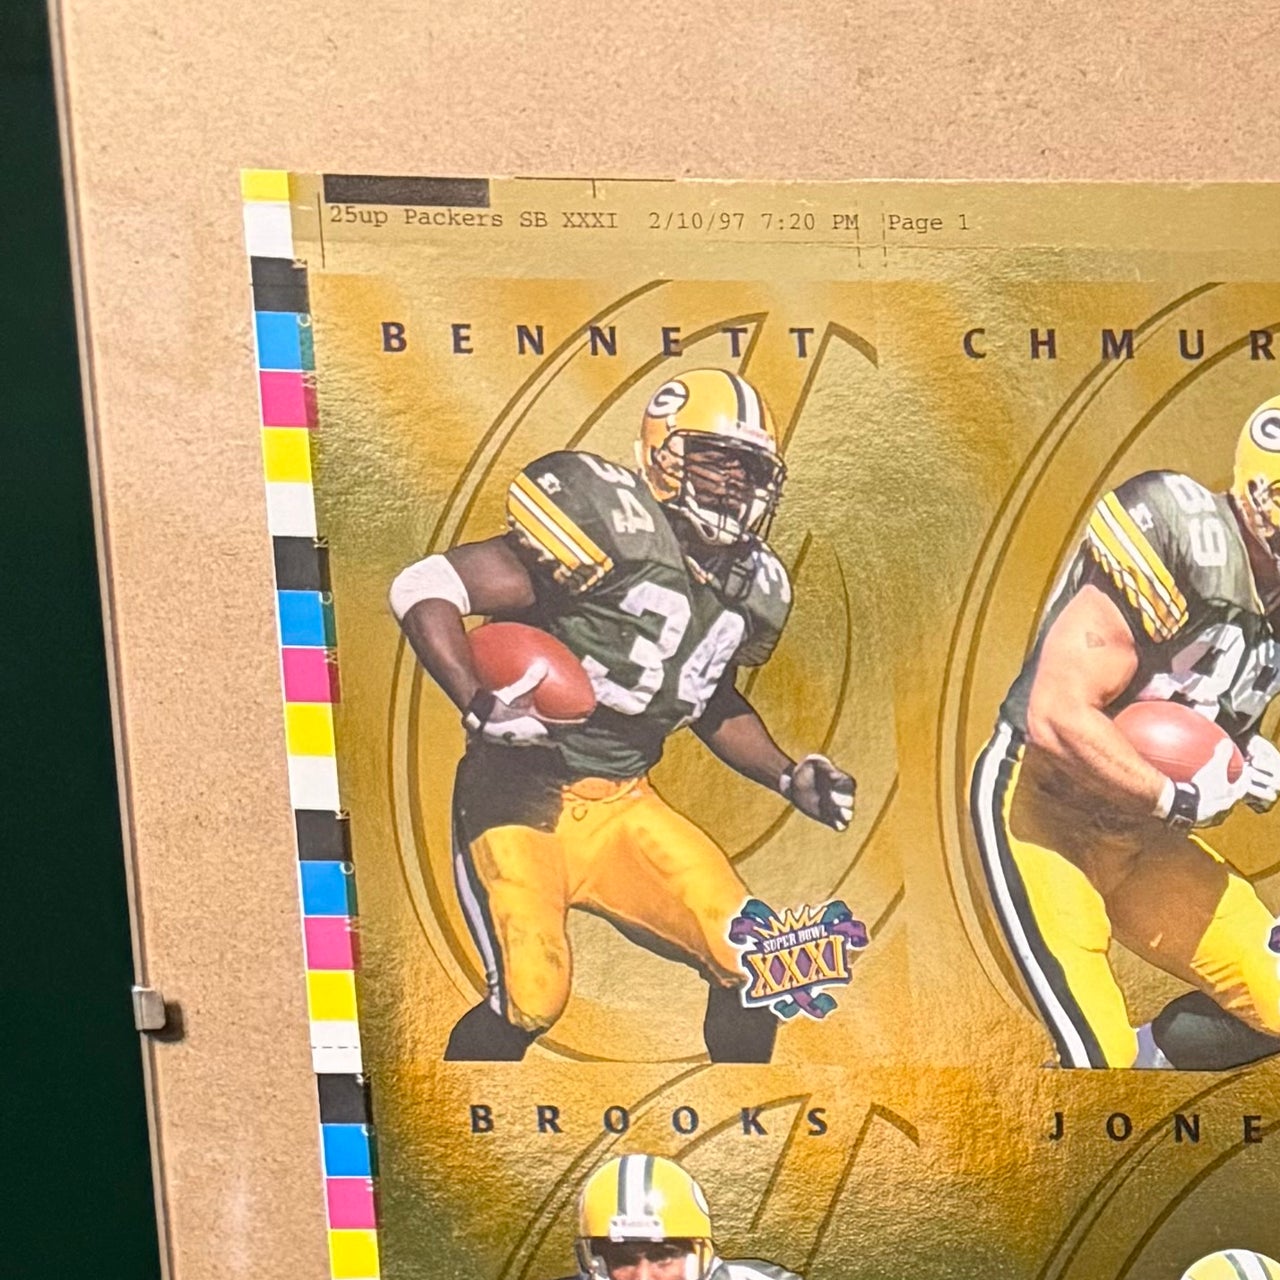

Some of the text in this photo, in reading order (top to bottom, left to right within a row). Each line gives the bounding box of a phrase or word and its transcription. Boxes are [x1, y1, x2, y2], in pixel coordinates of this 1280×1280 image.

[330, 205, 859, 231] 25up Packers SB XXXI 2/10/97 7:20 PM
[888, 214, 970, 233] Page 1
[381, 322, 814, 358] BENNETT
[763, 925, 828, 953] SUPER BOWL
[748, 936, 847, 997] XXXI
[470, 1104, 829, 1137] BROOKS
